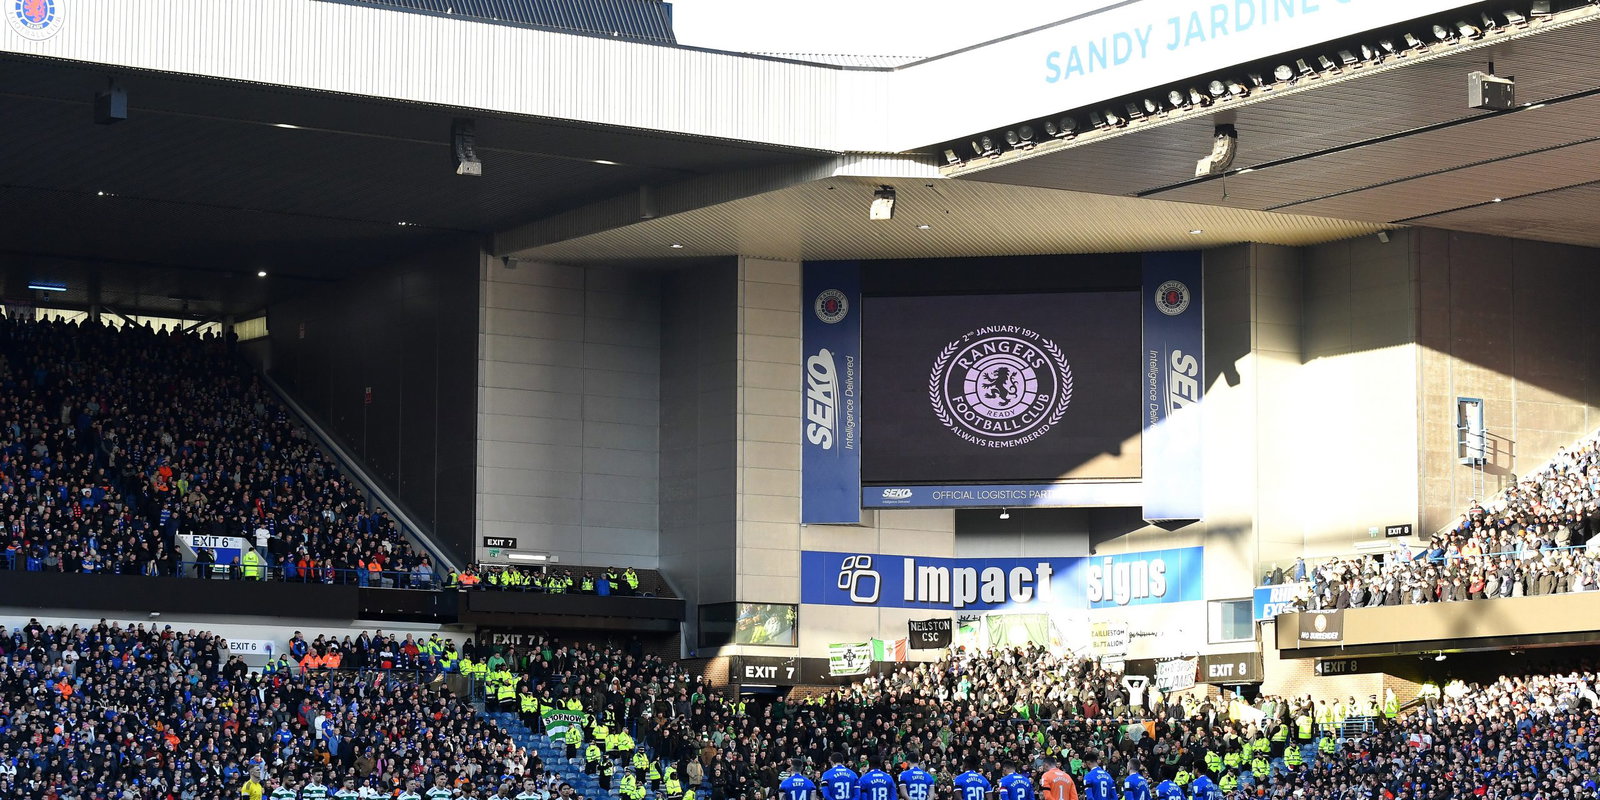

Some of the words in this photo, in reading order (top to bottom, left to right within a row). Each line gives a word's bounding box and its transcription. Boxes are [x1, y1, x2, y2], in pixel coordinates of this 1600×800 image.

[1045, 24, 1152, 84] SANDY
[976, 325, 1020, 336] JANUARY
[1021, 328, 1040, 340] 1971
[957, 341, 1045, 369] RANGERS
[845, 355, 855, 398] Delivered
[1148, 350, 1159, 402] Intelligence
[1172, 349, 1199, 409] SE
[807, 348, 834, 450] SEKO
[952, 395, 1021, 431] FOOTBALL
[1021, 394, 1050, 424] CLUB
[986, 409, 1016, 417] READY
[1149, 403, 1159, 428] Deliv
[845, 400, 856, 450] Intelligence
[951, 426, 986, 447] ALWAYS
[987, 424, 1050, 448] REMEMBERED
[882, 488, 913, 498] SEKO
[932, 490, 975, 500] OFFICIAL
[977, 490, 1027, 500] LOGISTICS
[1029, 490, 1054, 499] PART
[1387, 527, 1402, 535] EXIT
[1404, 526, 1409, 534] 8
[192, 535, 219, 547] EXIT
[222, 537, 229, 548] 6
[487, 538, 505, 546] EXIT
[903, 557, 1053, 608] Impact
[1088, 556, 1167, 606] signs
[911, 620, 951, 631] NEILSTON
[493, 634, 523, 645] EXIT
[527, 635, 536, 645] 7
[922, 632, 939, 642] CSC
[231, 642, 250, 650] EXIT
[251, 643, 257, 651] 6
[745, 665, 778, 679] EXIT
[785, 667, 795, 680] 7
[1209, 663, 1234, 677] EXIT
[1238, 662, 1247, 676] 8
[1323, 661, 1347, 673] EXIT
[1350, 660, 1358, 672] 8
[545, 713, 583, 724] STORNOW
[790, 789, 807, 800] 14
[834, 781, 851, 800] 31
[871, 787, 888, 800] 18
[909, 783, 928, 800] 26
[966, 786, 985, 800] 20
[1016, 787, 1026, 800] 2
[1058, 784, 1065, 800] 1
[1100, 780, 1108, 798] 6
